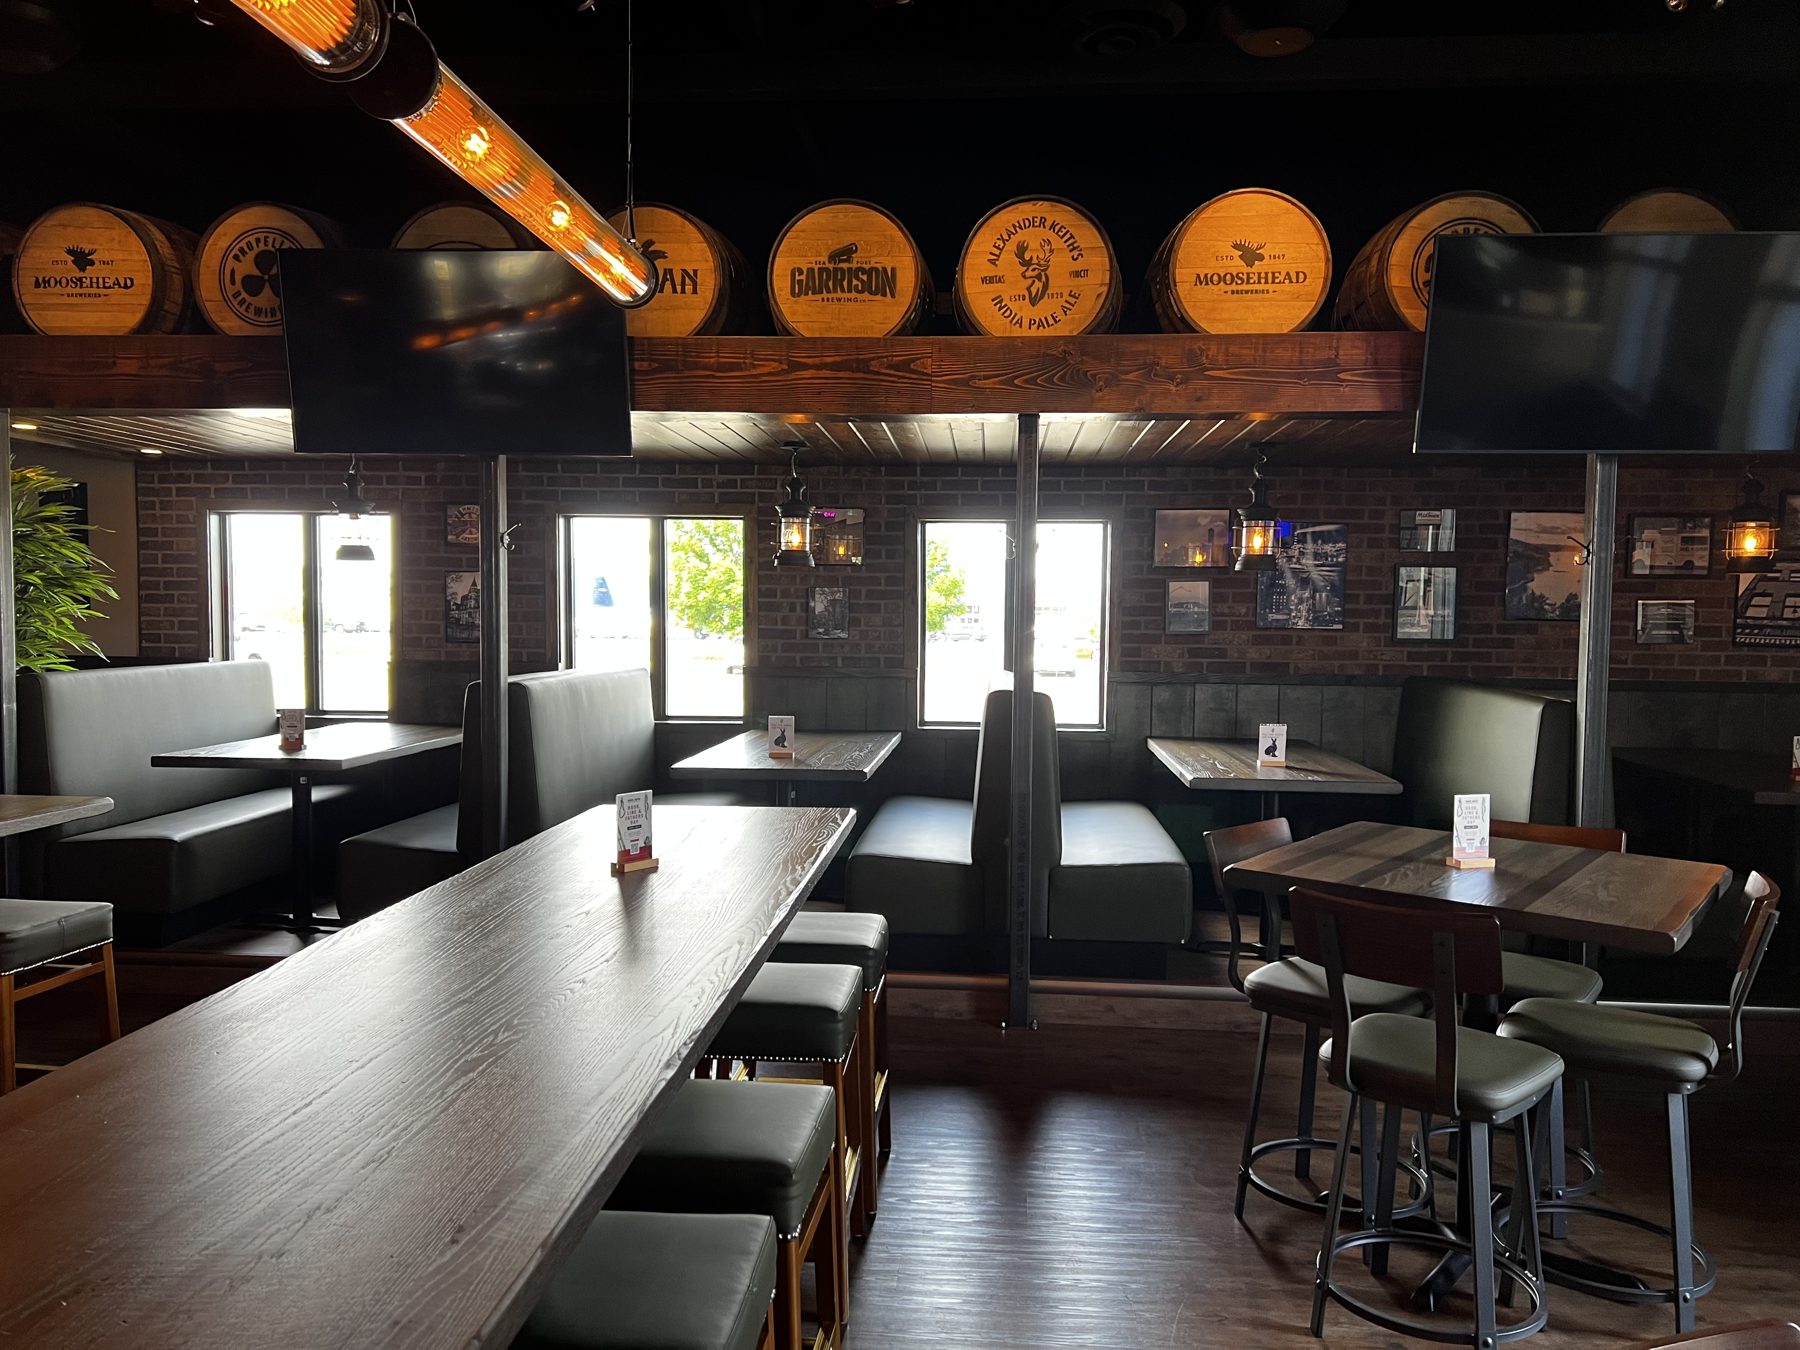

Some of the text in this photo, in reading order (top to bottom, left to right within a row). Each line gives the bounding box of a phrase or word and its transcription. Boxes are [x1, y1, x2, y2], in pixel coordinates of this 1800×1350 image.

[987, 216, 1084, 267] ALEXANDER KEITH'S
[34, 275, 135, 290] MOOSEHEAD
[790, 266, 897, 299] GARRISON
[1194, 271, 1308, 286] MOOSEHEAD
[232, 290, 281, 318] BREWIN
[991, 290, 1081, 331] INDIA PALE ALE
